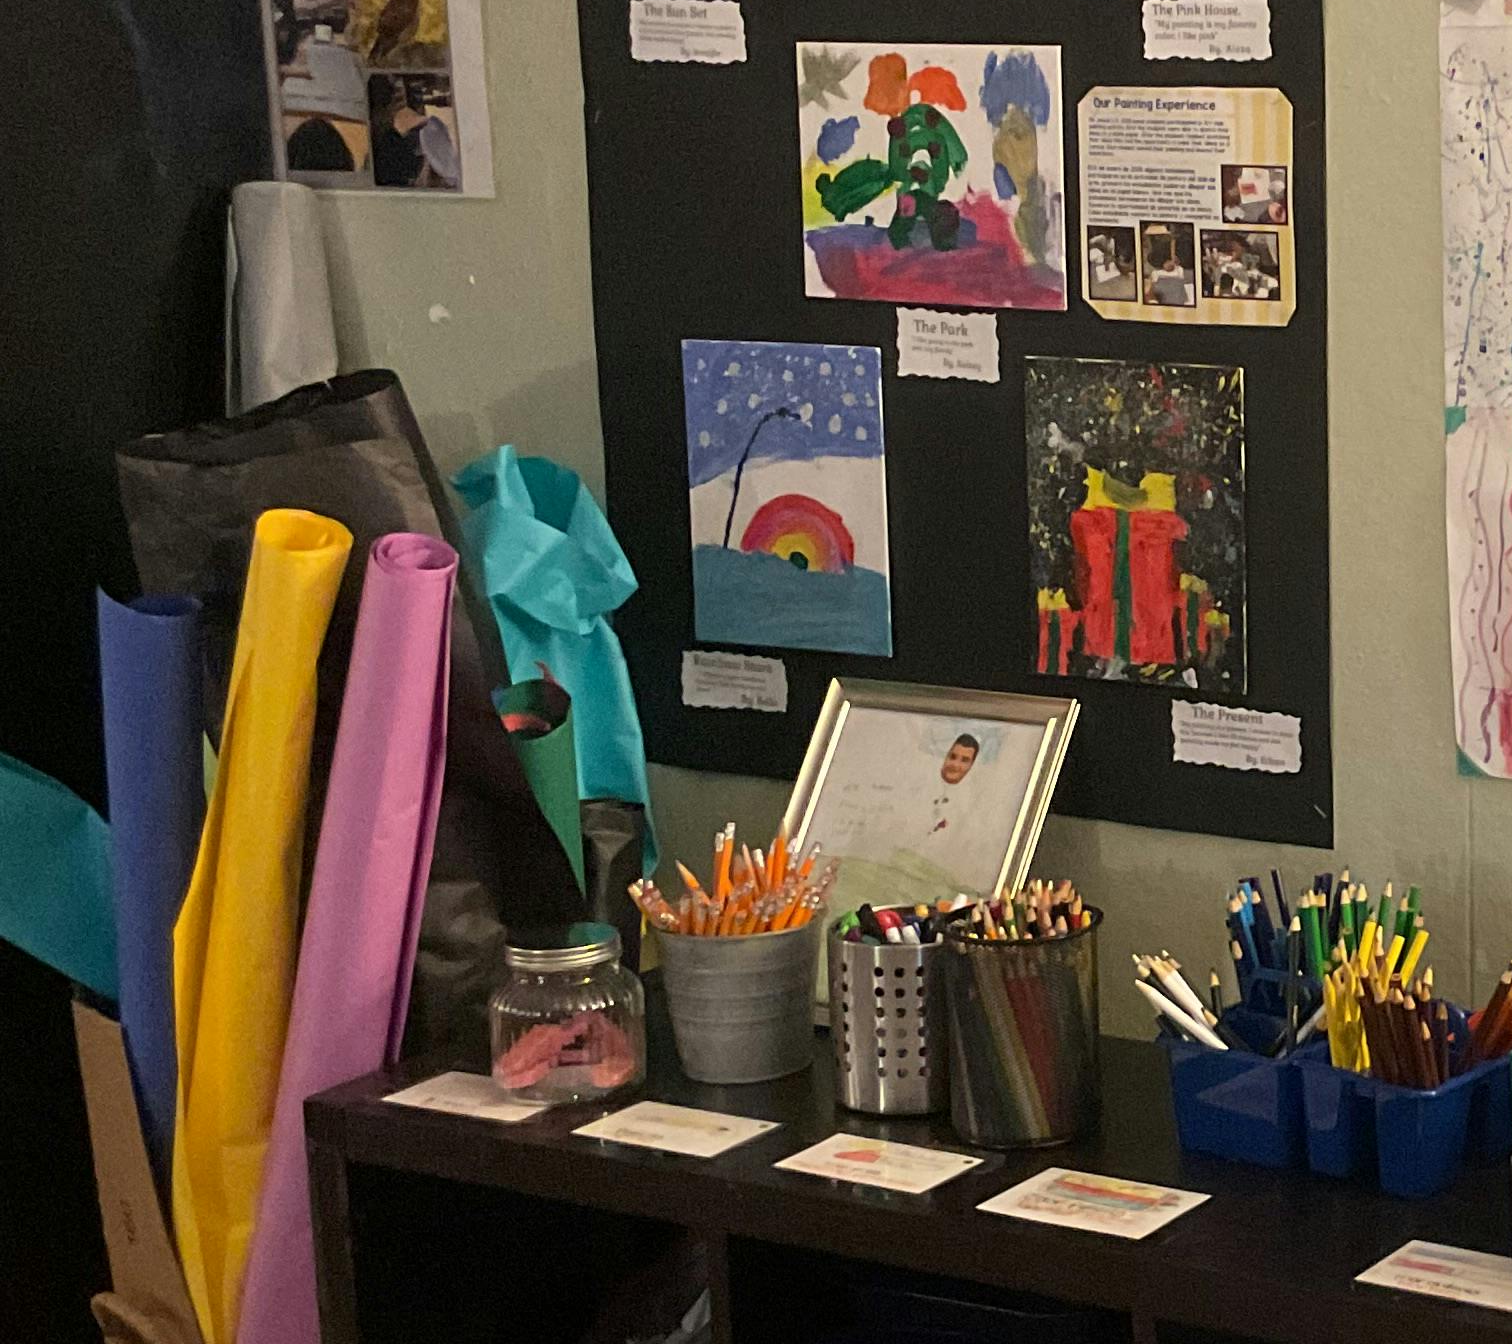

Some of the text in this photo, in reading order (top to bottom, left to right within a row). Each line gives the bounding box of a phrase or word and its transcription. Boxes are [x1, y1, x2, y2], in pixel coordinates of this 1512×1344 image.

[1152, 3, 1173, 17] The
[1176, 2, 1201, 17] Pink
[1093, 97, 1216, 113] Our Painting Experience
[913, 318, 969, 337] The Park
[1191, 706, 1264, 725] The Present
